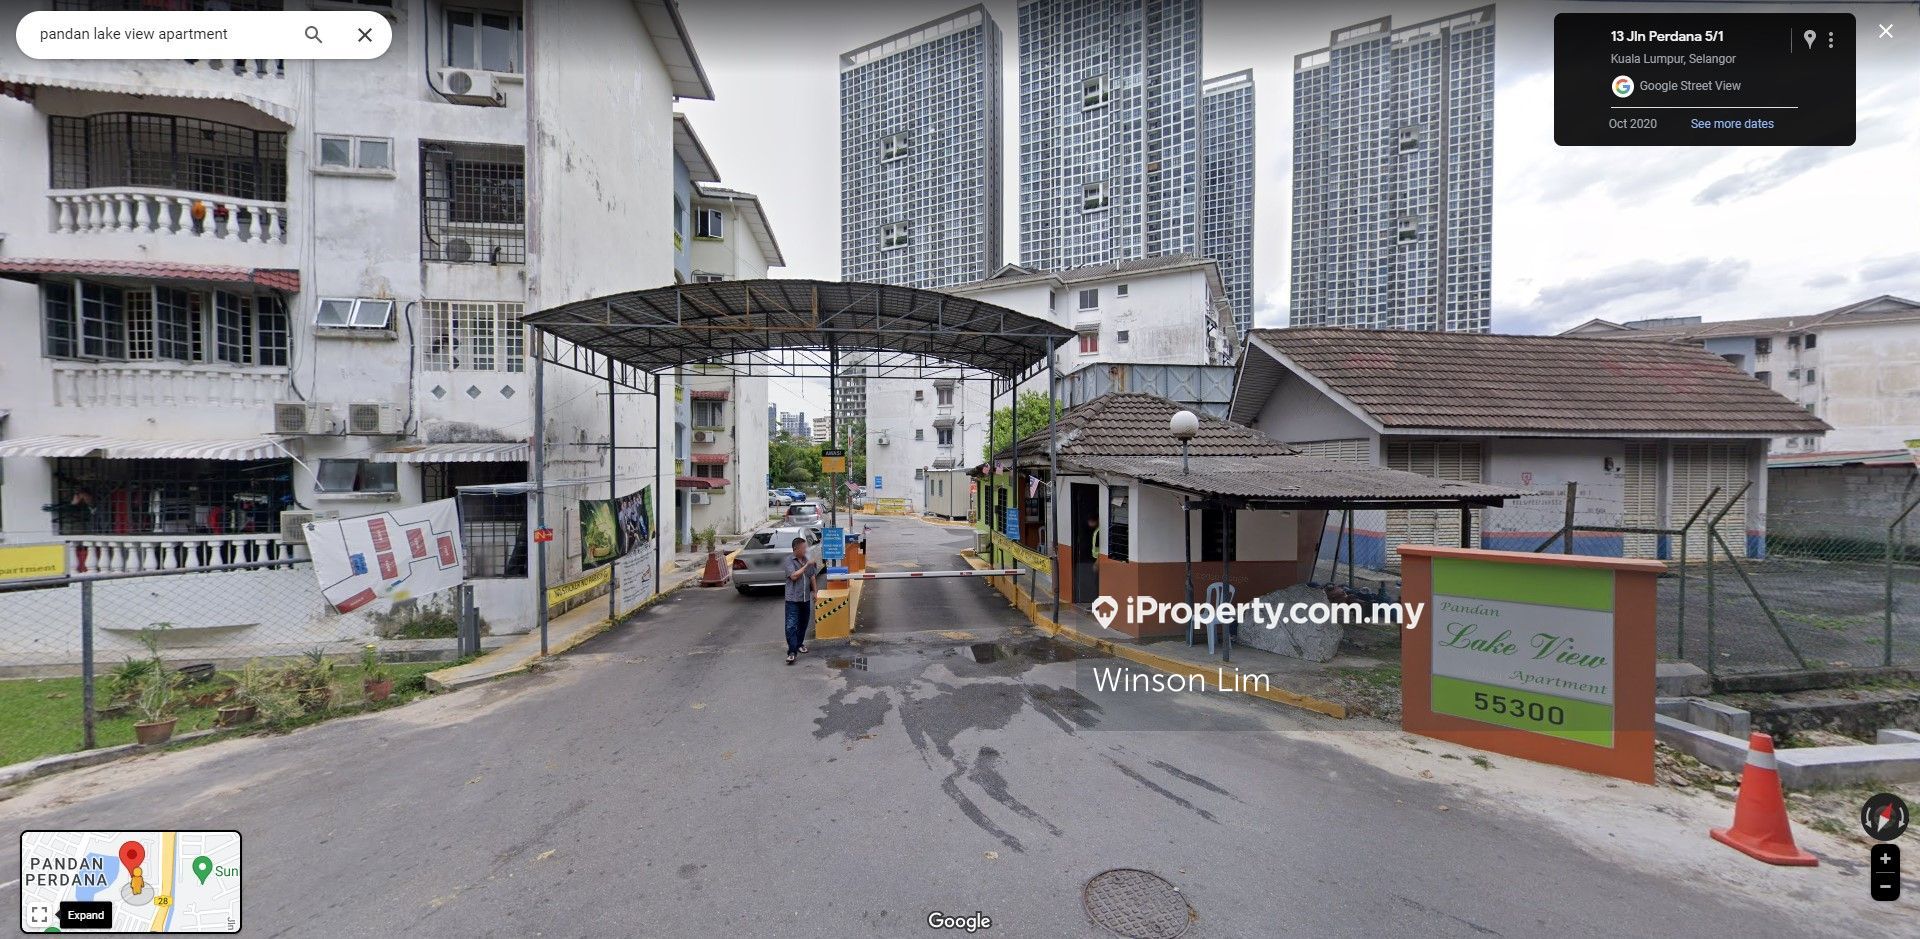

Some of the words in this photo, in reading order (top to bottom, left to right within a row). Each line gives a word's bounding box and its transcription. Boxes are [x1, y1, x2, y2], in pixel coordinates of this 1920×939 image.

[1440, 601, 1501, 617] Pandan
[1438, 622, 1519, 656] Lake
[1529, 632, 1608, 669] View
[1508, 669, 1608, 695] Apartment
[1474, 691, 1564, 726] 55300
